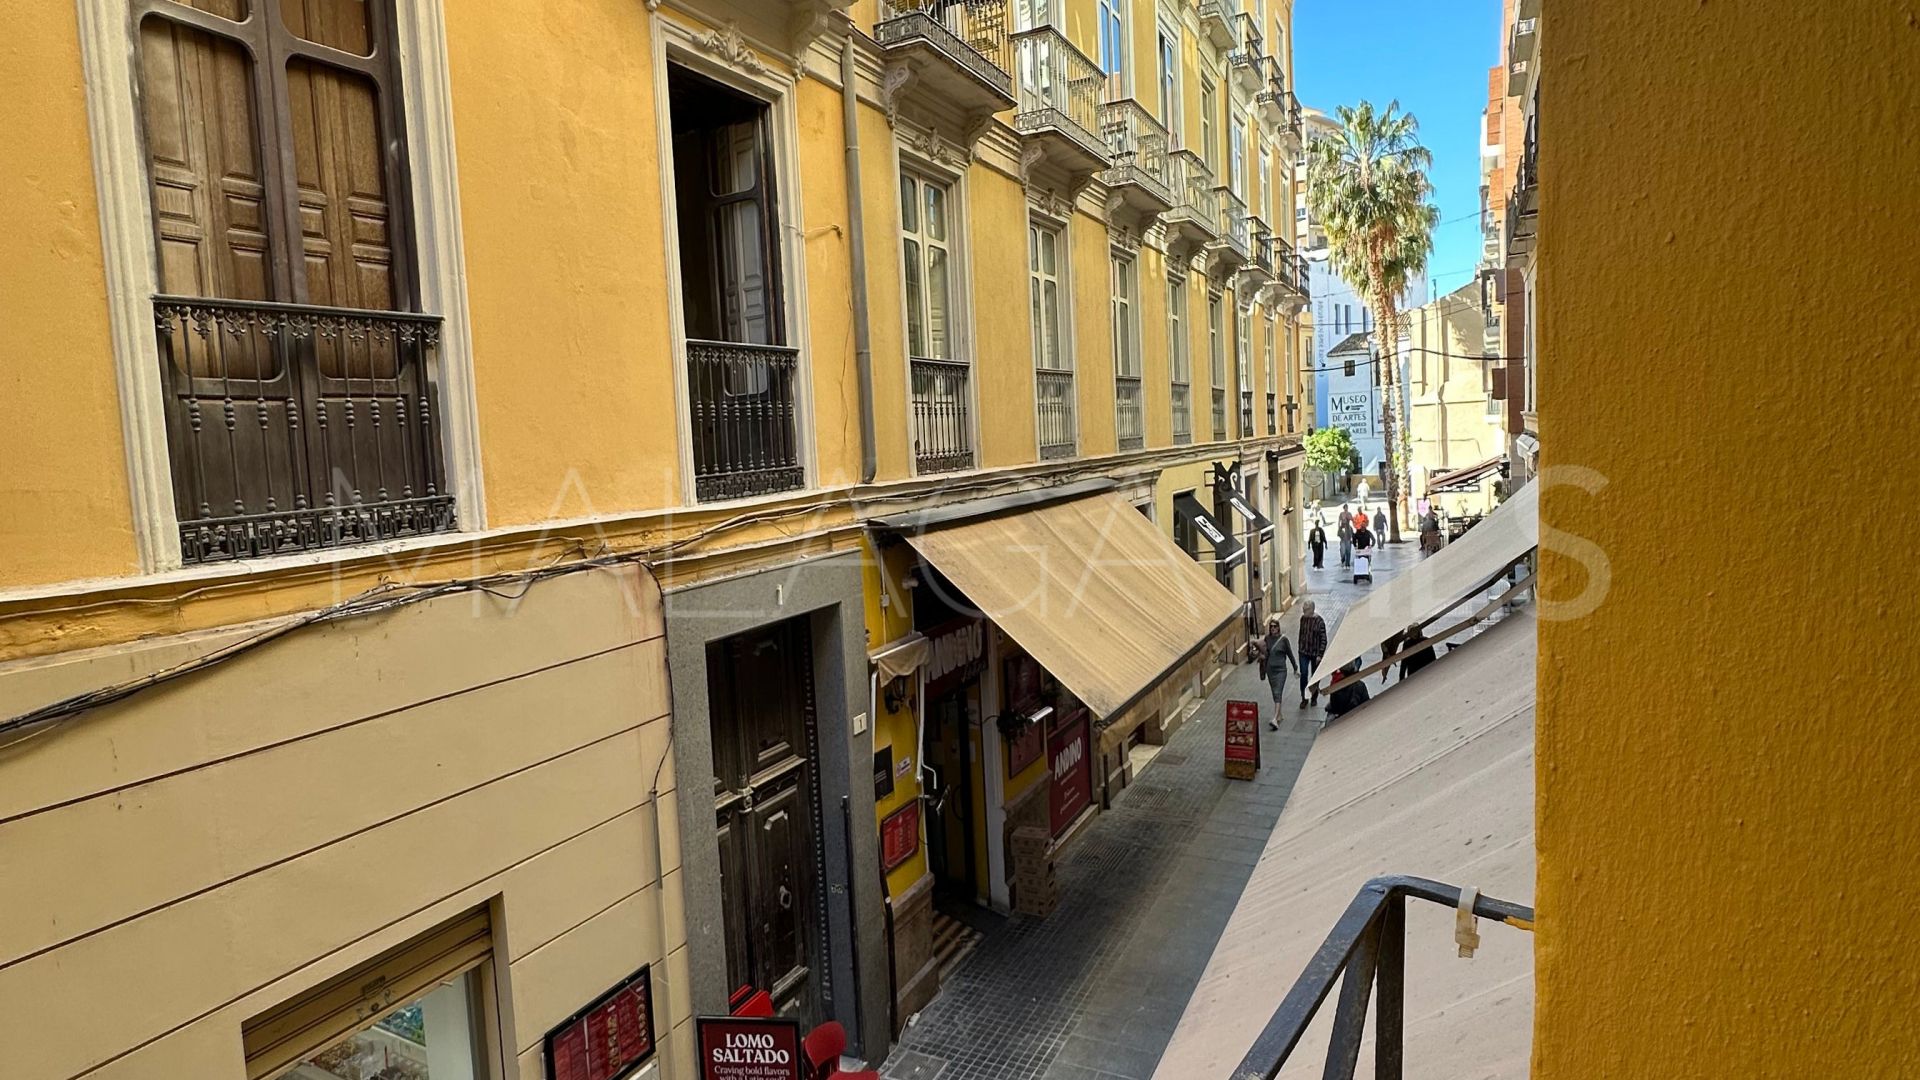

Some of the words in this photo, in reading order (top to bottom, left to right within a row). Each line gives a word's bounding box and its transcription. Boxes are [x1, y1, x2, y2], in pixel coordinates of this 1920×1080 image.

[1331, 395, 1367, 413] MUSEO
[1332, 414, 1341, 422] DE
[1343, 413, 1367, 421] ARTES
[1054, 736, 1082, 781] ANDINO
[726, 1033, 774, 1048] LOMO
[713, 1048, 789, 1064] SALTADO
[714, 1065, 744, 1076] Craving
[745, 1066, 762, 1075] bold
[764, 1066, 790, 1076] flavors
